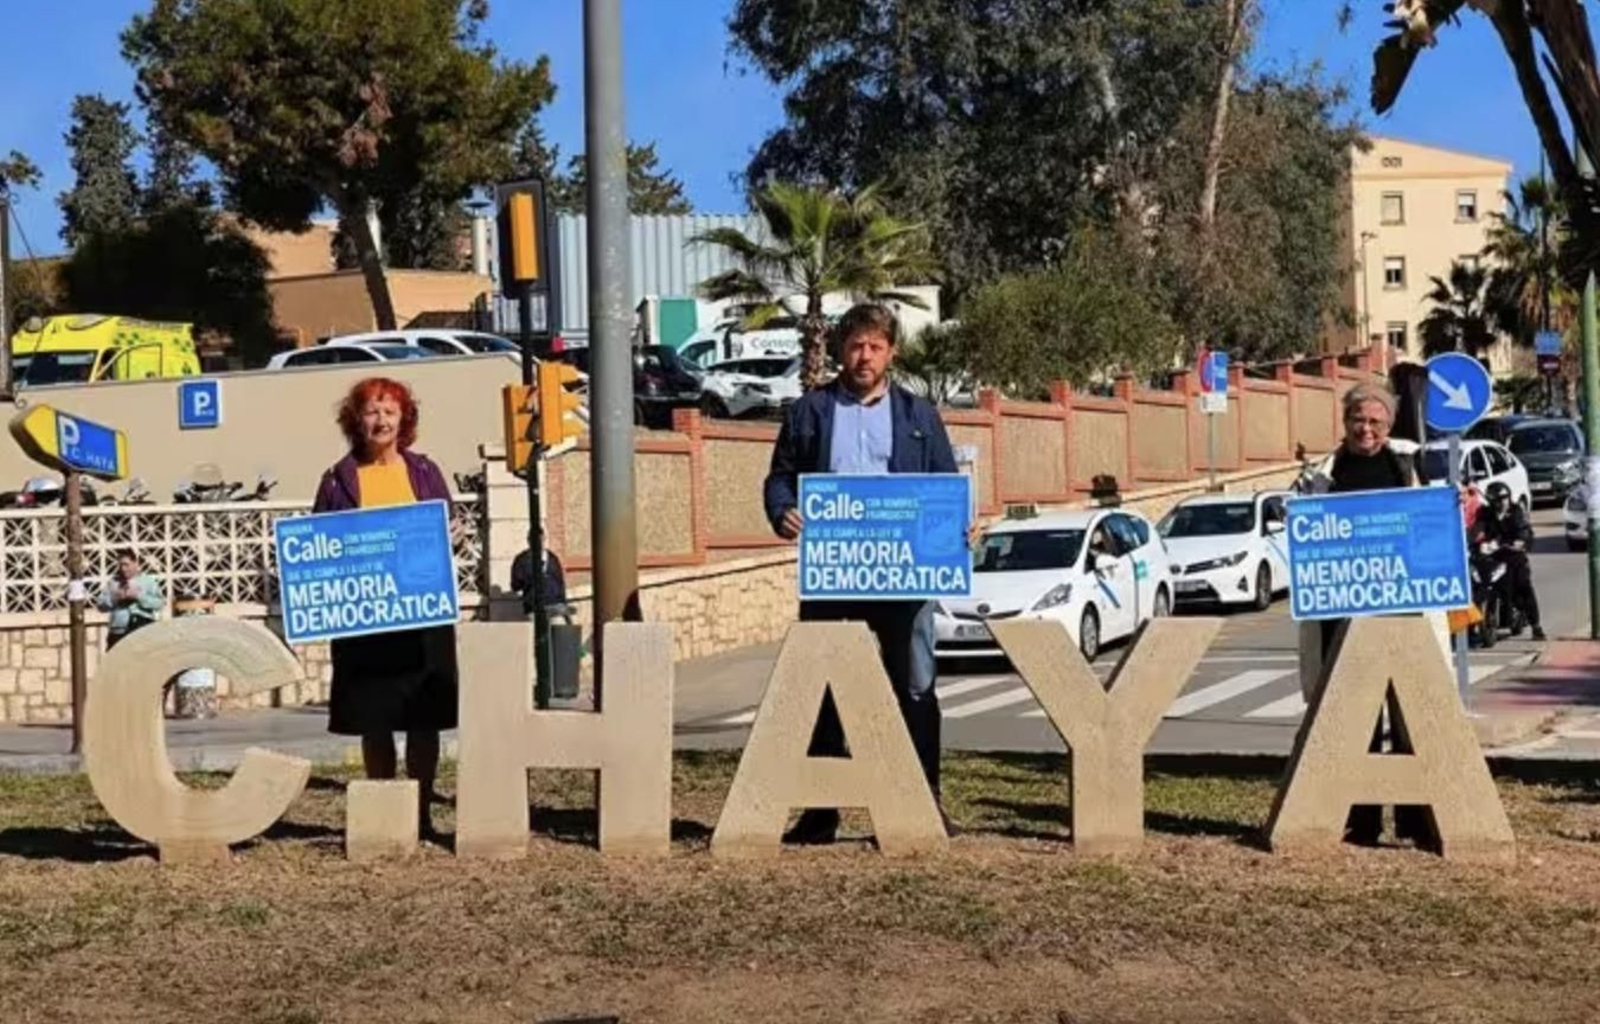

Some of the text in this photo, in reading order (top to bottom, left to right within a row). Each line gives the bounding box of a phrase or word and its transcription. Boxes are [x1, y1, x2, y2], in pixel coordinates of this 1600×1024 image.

[193, 390, 211, 416] P
[58, 413, 81, 457] P
[805, 493, 865, 521] Calle
[1292, 513, 1352, 543] Calle
[282, 532, 343, 564] Calle
[806, 541, 914, 565] MEMORIA
[806, 566, 967, 591] DEMOCRÁTICA
[1295, 555, 1408, 586] MEMORIA
[287, 573, 398, 608] MEMORIA
[1298, 577, 1465, 612] DEMOCRÁTICA
[291, 591, 453, 633] DEMOCRÁTICA
